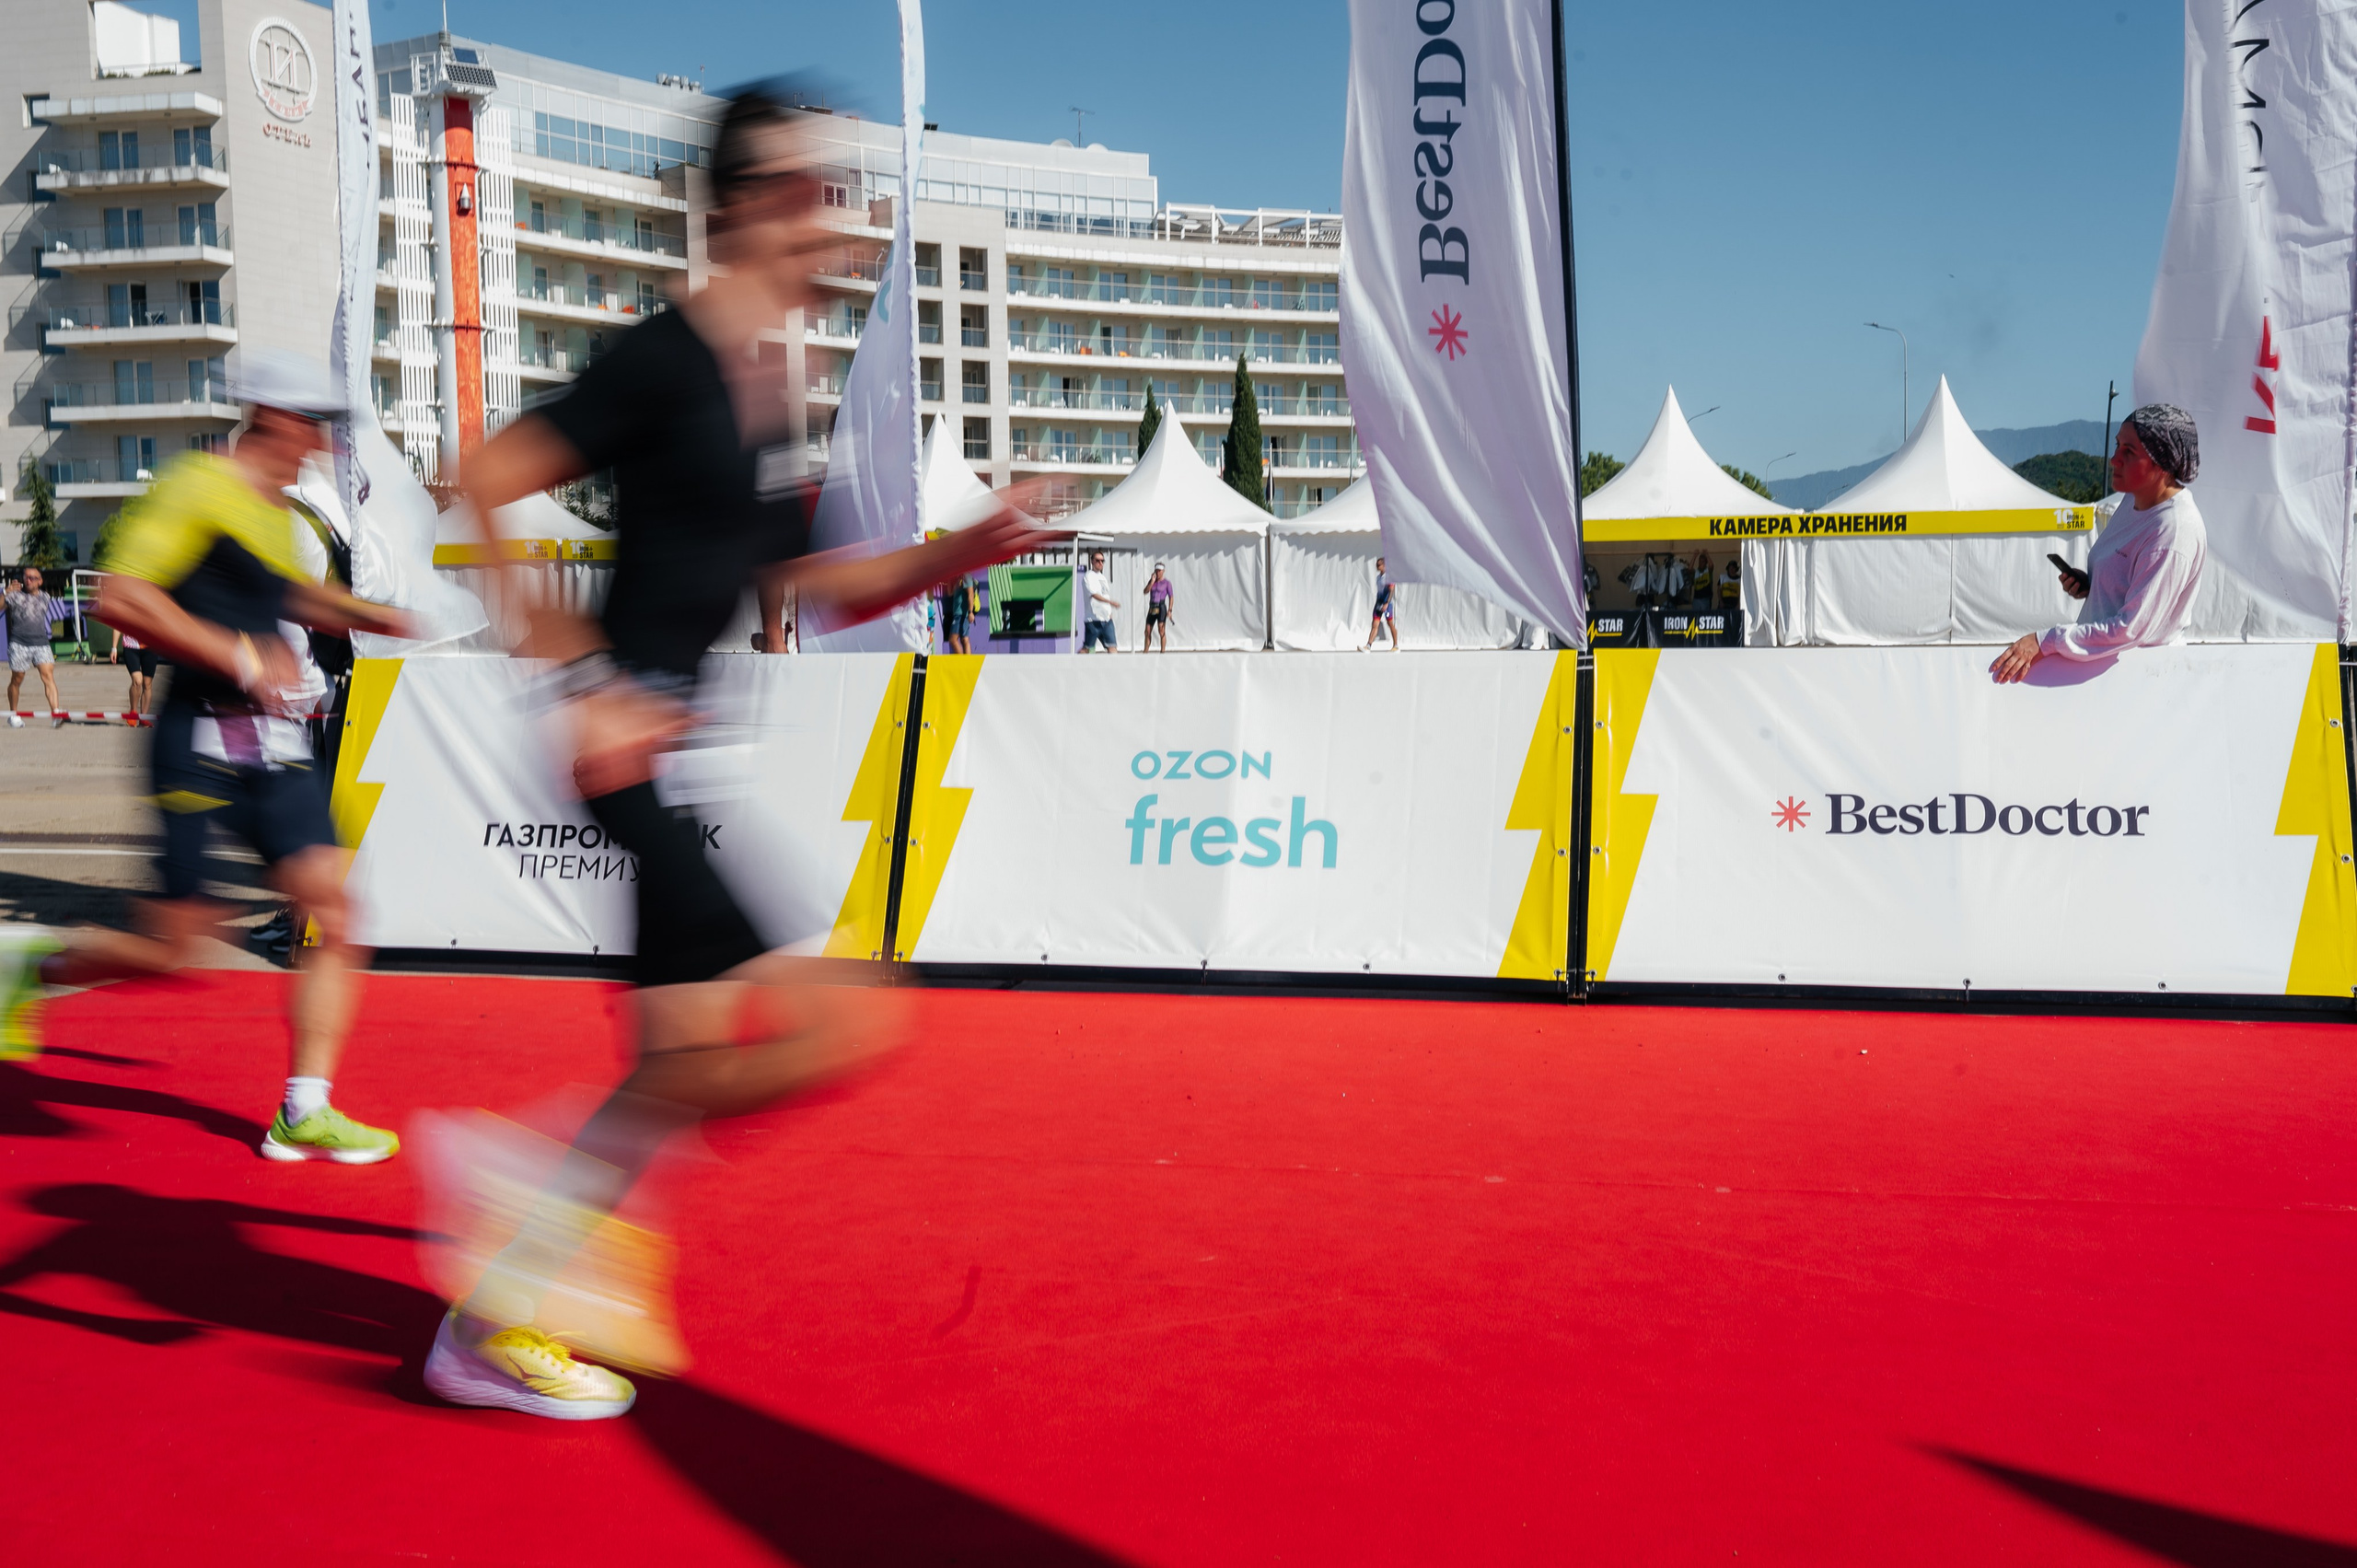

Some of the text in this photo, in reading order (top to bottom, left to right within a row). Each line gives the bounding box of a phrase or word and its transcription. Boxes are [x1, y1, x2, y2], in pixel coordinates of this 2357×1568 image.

[1710, 515, 1907, 536] КАМЕРА ХРАНЕНИЯ
[534, 551, 549, 559] STAR
[1597, 618, 1623, 633] STAR
[1664, 615, 1724, 631] IRON STAR
[1131, 749, 1272, 781] OZON
[1825, 793, 2150, 837] BestDoctor
[483, 822, 723, 850] ГАЗПРОМК
[1125, 794, 1339, 869] fresh
[518, 854, 642, 882] ПРЕМИУ
